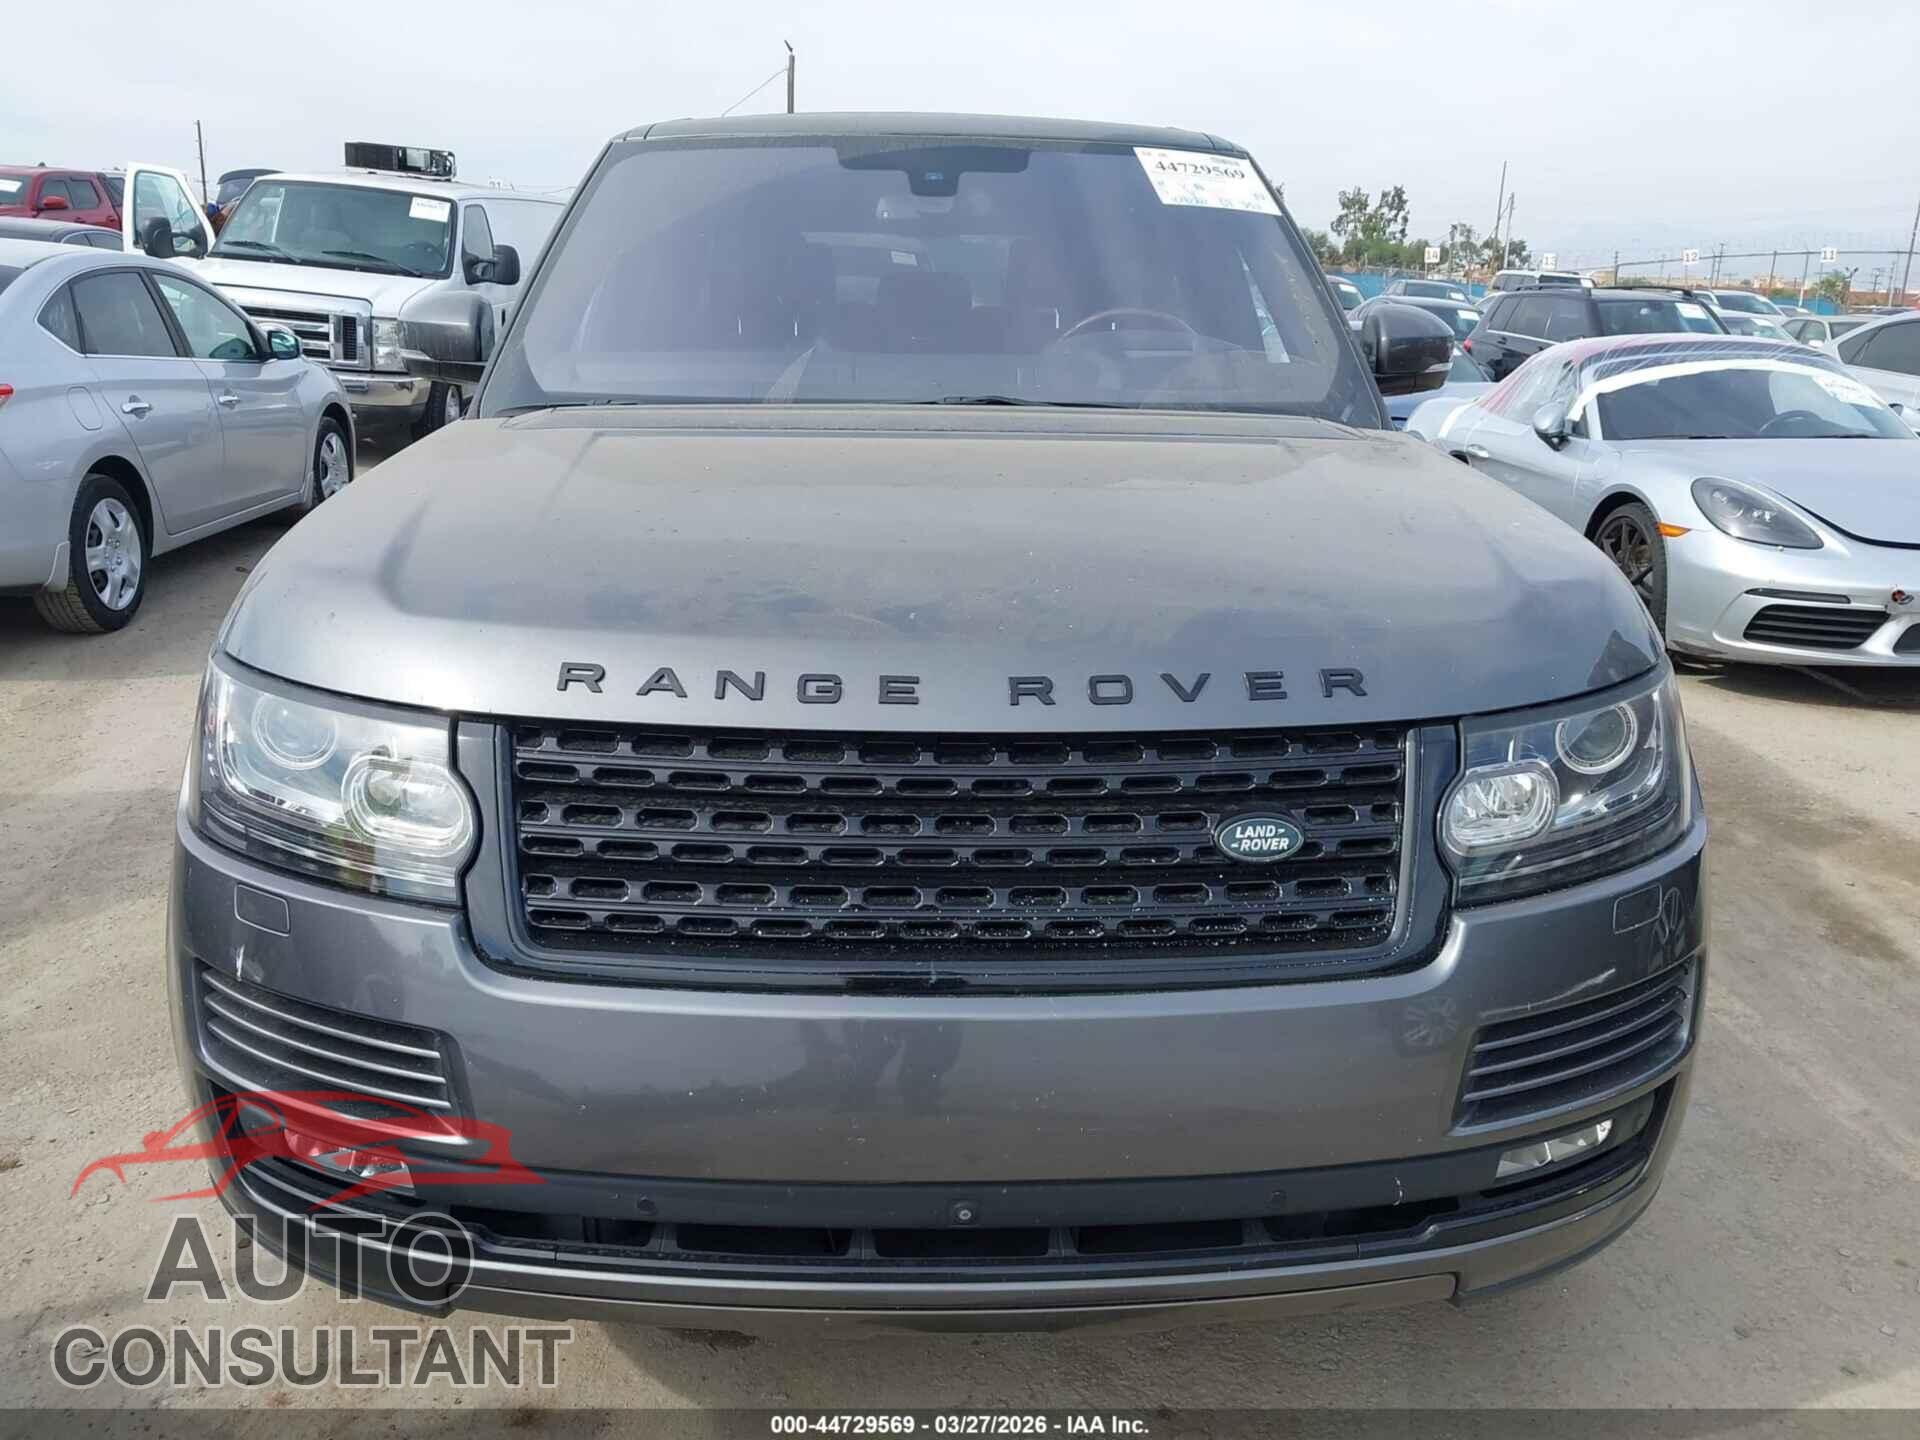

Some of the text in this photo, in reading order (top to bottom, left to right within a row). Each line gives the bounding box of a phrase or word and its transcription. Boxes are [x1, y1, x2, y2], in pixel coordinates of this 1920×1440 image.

[1155, 160, 1245, 179] 44729569
[1684, 251, 1698, 262] 12
[1822, 249, 1835, 260] 11
[557, 662, 1368, 706] RANGE ROVER
